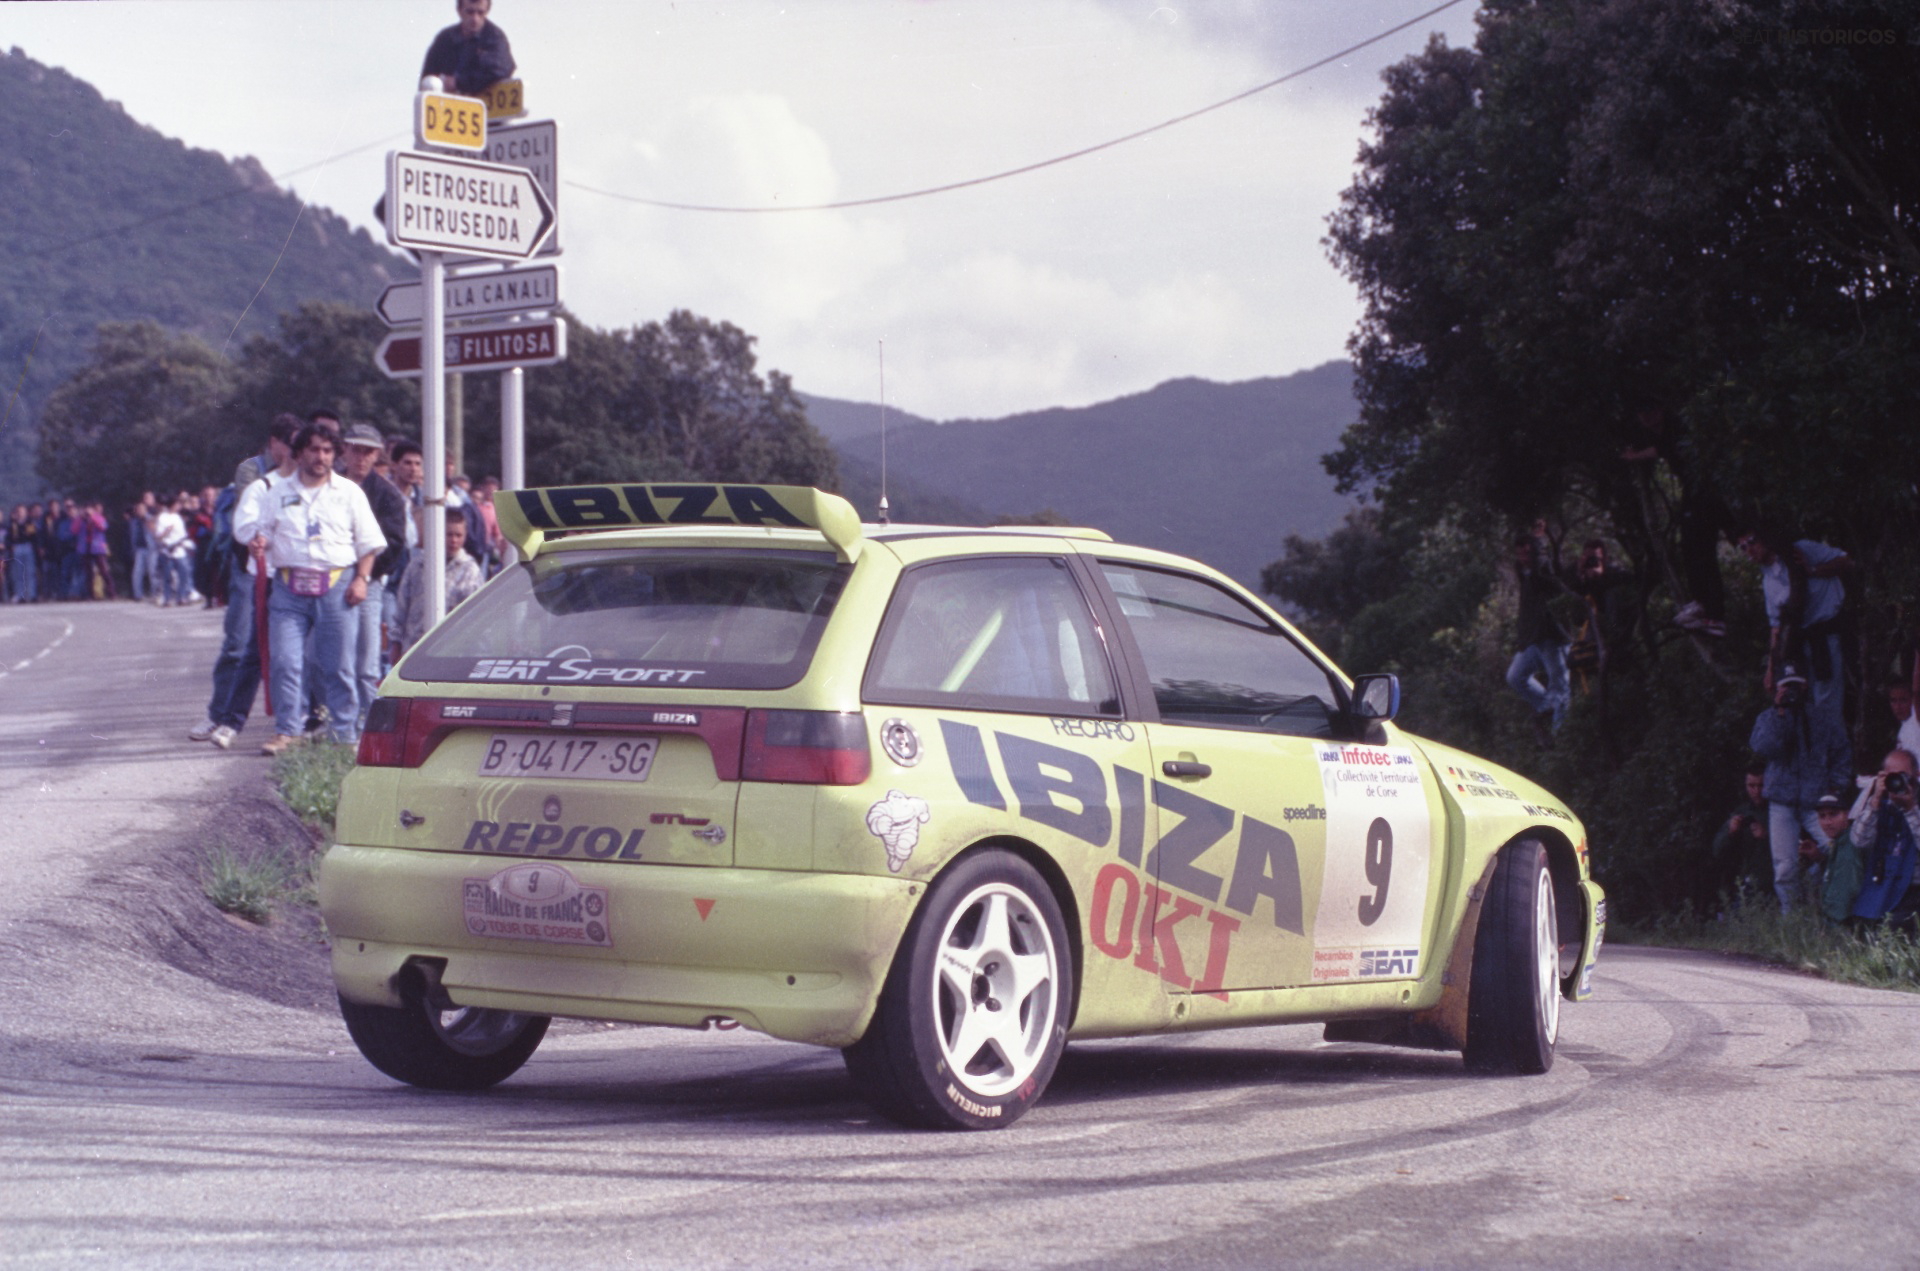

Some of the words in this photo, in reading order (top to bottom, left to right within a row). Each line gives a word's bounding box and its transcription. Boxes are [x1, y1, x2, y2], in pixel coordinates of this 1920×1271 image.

[426, 105, 437, 130] D
[443, 108, 480, 138] 255
[403, 167, 520, 210] PIETROSELLA
[403, 202, 520, 243] PITRUSEDDA
[482, 279, 550, 304] CANALI
[462, 331, 551, 359] FILITOSA
[514, 486, 812, 527] IBIZA
[468, 659, 550, 680] SEAT
[443, 705, 477, 718] SEAT
[652, 712, 698, 725] IBIZA
[1050, 717, 1135, 742] RECARO
[1340, 746, 1391, 766] infotec
[1366, 785, 1376, 797] de
[1376, 785, 1398, 798] Corse
[1283, 803, 1326, 822] speedline
[937, 717, 1305, 937] IBIZA
[463, 820, 646, 861] REPSOL
[527, 870, 541, 894] 9
[1358, 816, 1393, 927] 9
[484, 883, 522, 919] RALLYE
[524, 903, 539, 919] DE
[541, 892, 584, 923] FRANCE
[487, 919, 522, 935] TOUR
[524, 923, 542, 937] DE
[543, 924, 586, 941] CORSE
[1090, 862, 1241, 1003] OKI
[1314, 950, 1354, 962] Recambios
[1358, 949, 1419, 976] SEAT
[1313, 967, 1350, 980] Originales
[946, 1083, 1002, 1118] MICHELIN
